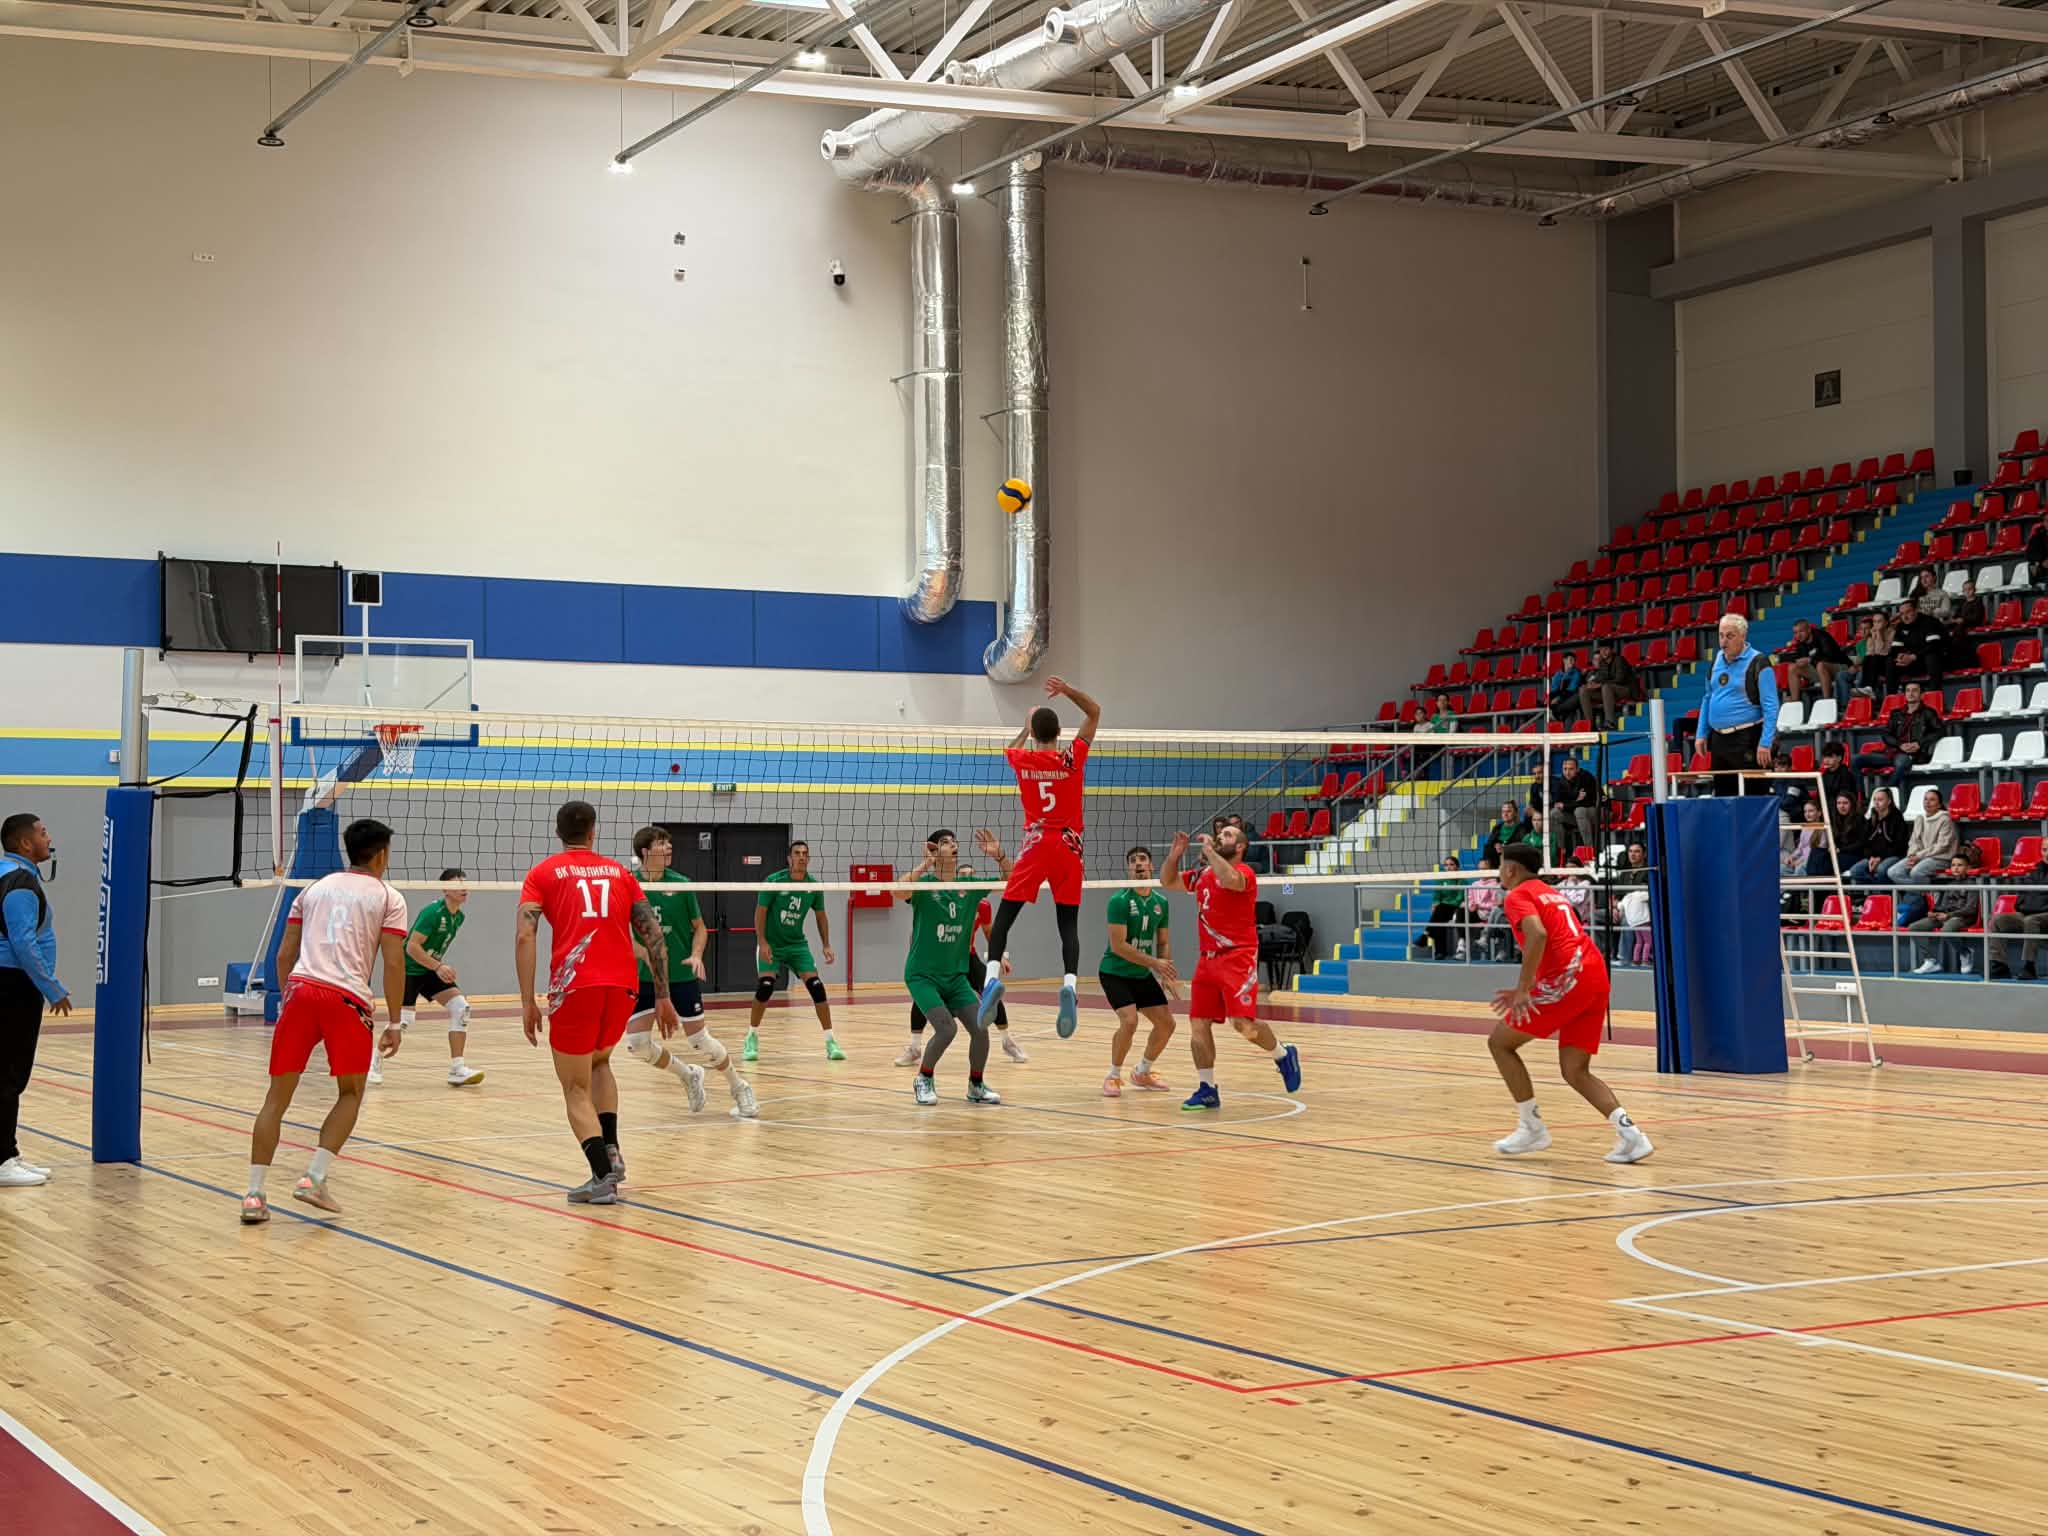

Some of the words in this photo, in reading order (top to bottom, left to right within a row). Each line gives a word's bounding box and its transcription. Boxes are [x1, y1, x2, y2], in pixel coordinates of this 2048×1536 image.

[1038, 781, 1056, 812] 5
[576, 879, 610, 918] 17
[949, 902, 957, 919] 8
[1557, 903, 1580, 937] 7
